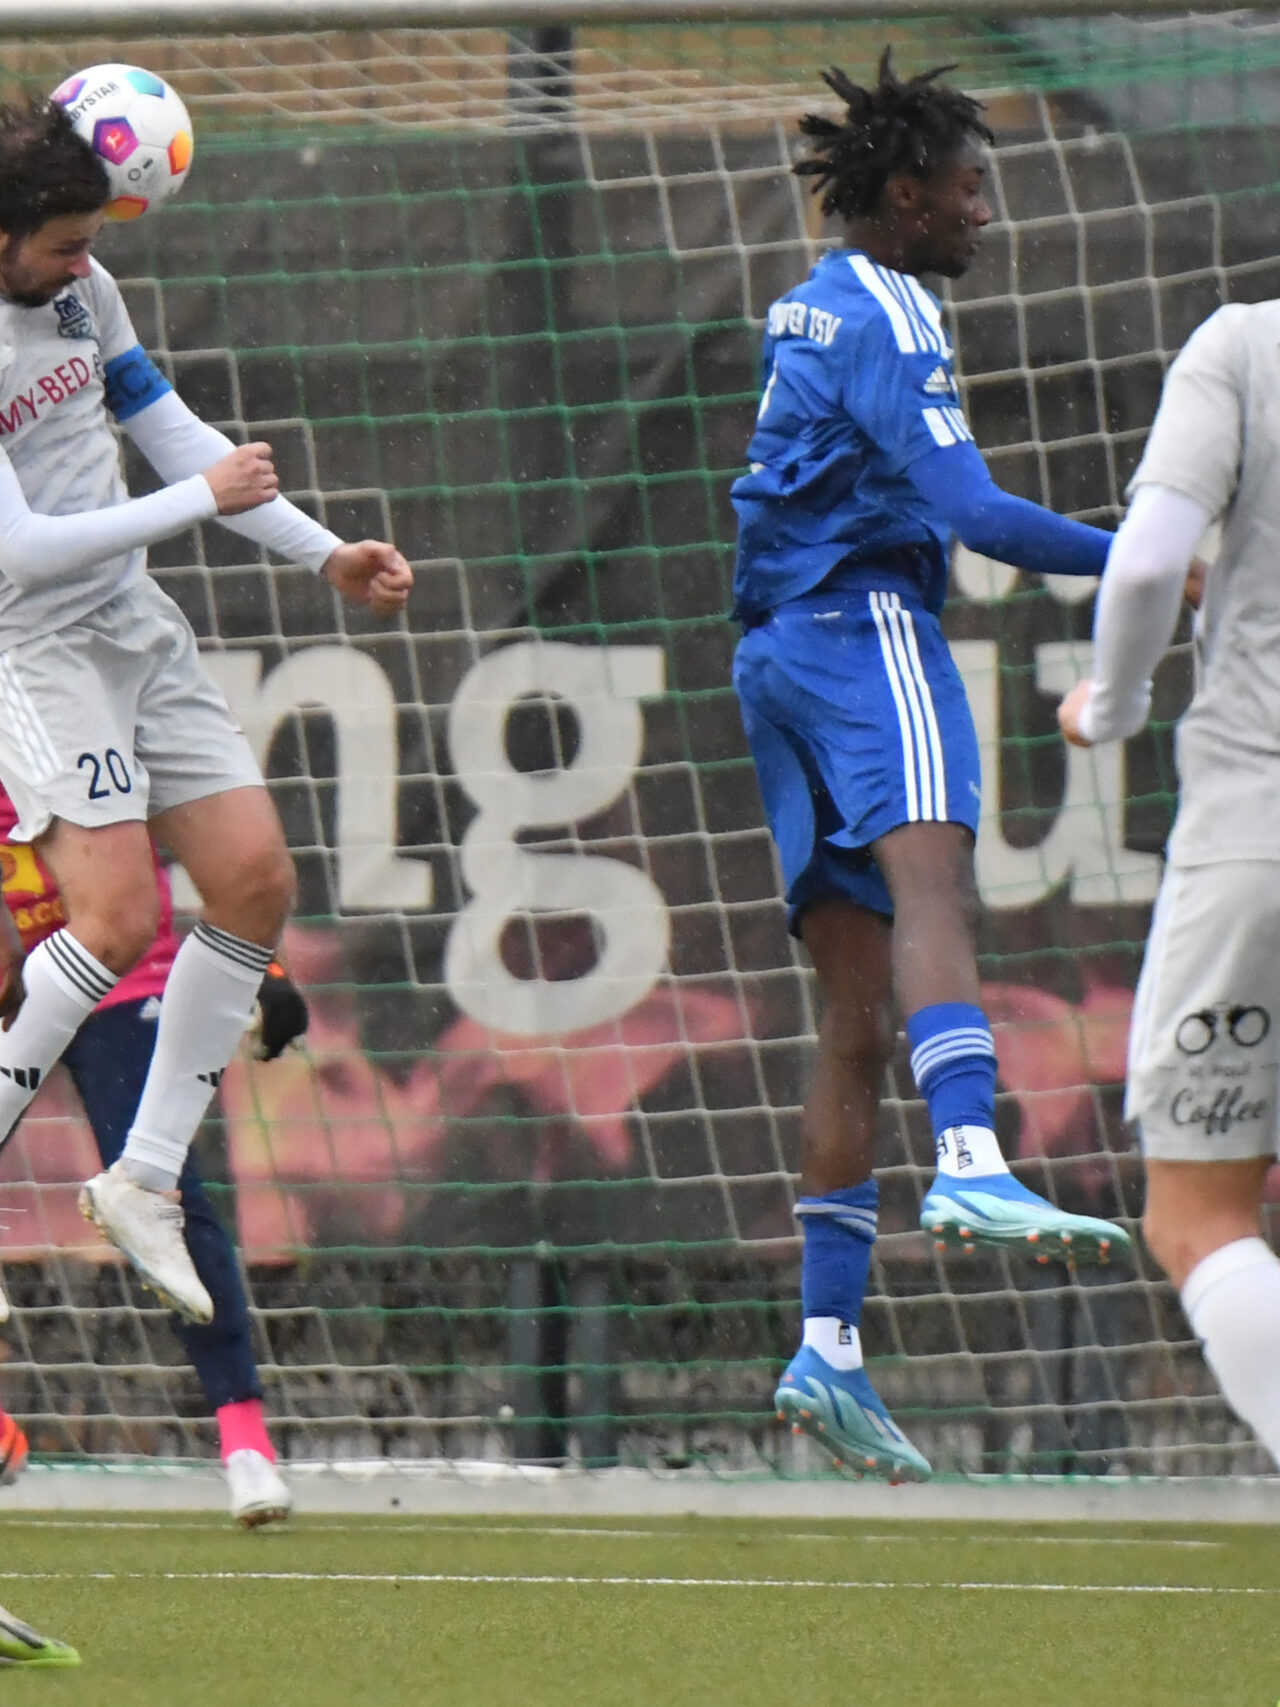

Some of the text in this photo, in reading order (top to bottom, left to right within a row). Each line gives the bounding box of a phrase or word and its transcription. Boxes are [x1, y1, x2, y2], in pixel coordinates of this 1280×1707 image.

[808, 307, 842, 346] TSV
[77, 747, 132, 800] 20
[1170, 1085, 1268, 1136] Coffee
